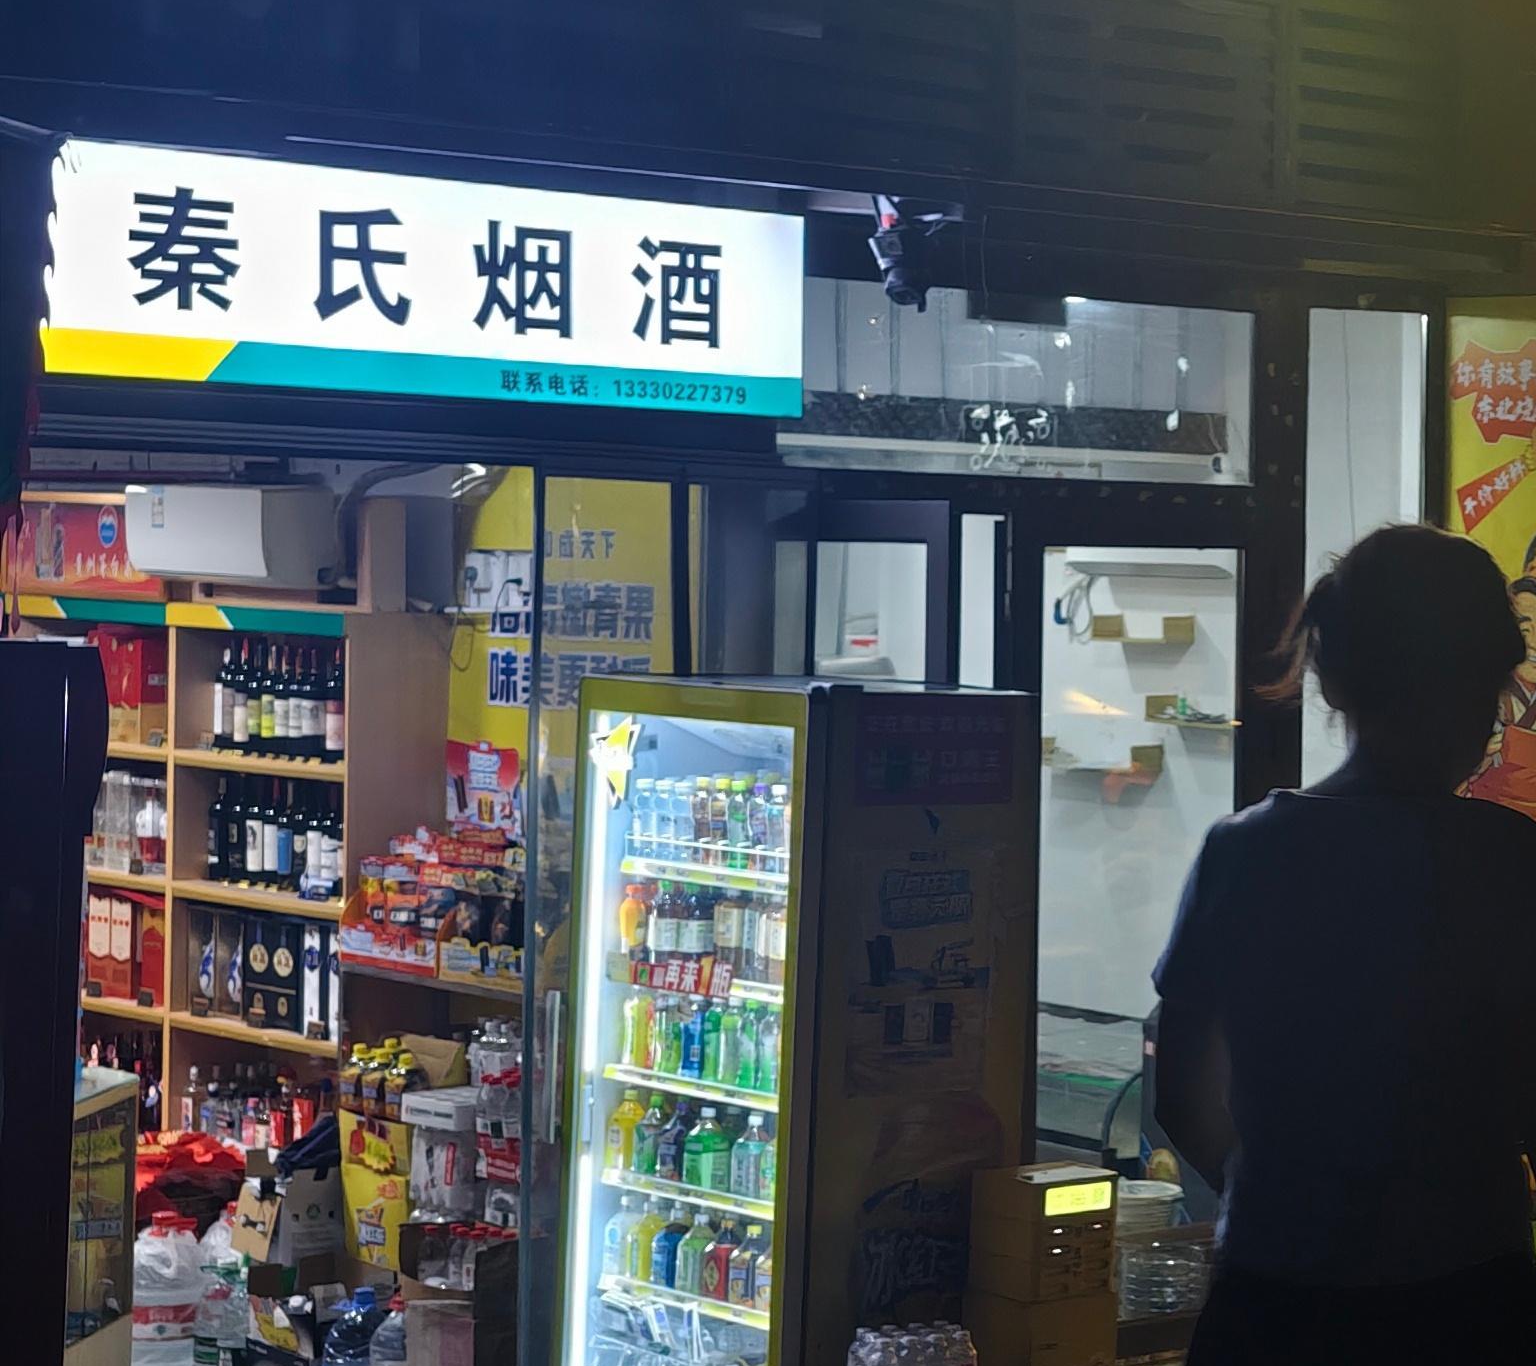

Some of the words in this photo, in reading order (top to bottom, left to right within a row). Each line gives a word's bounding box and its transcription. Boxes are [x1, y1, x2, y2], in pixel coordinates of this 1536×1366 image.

[127, 186, 723, 349] 秦氏烟酒
[612, 378, 748, 406] 13330227379
